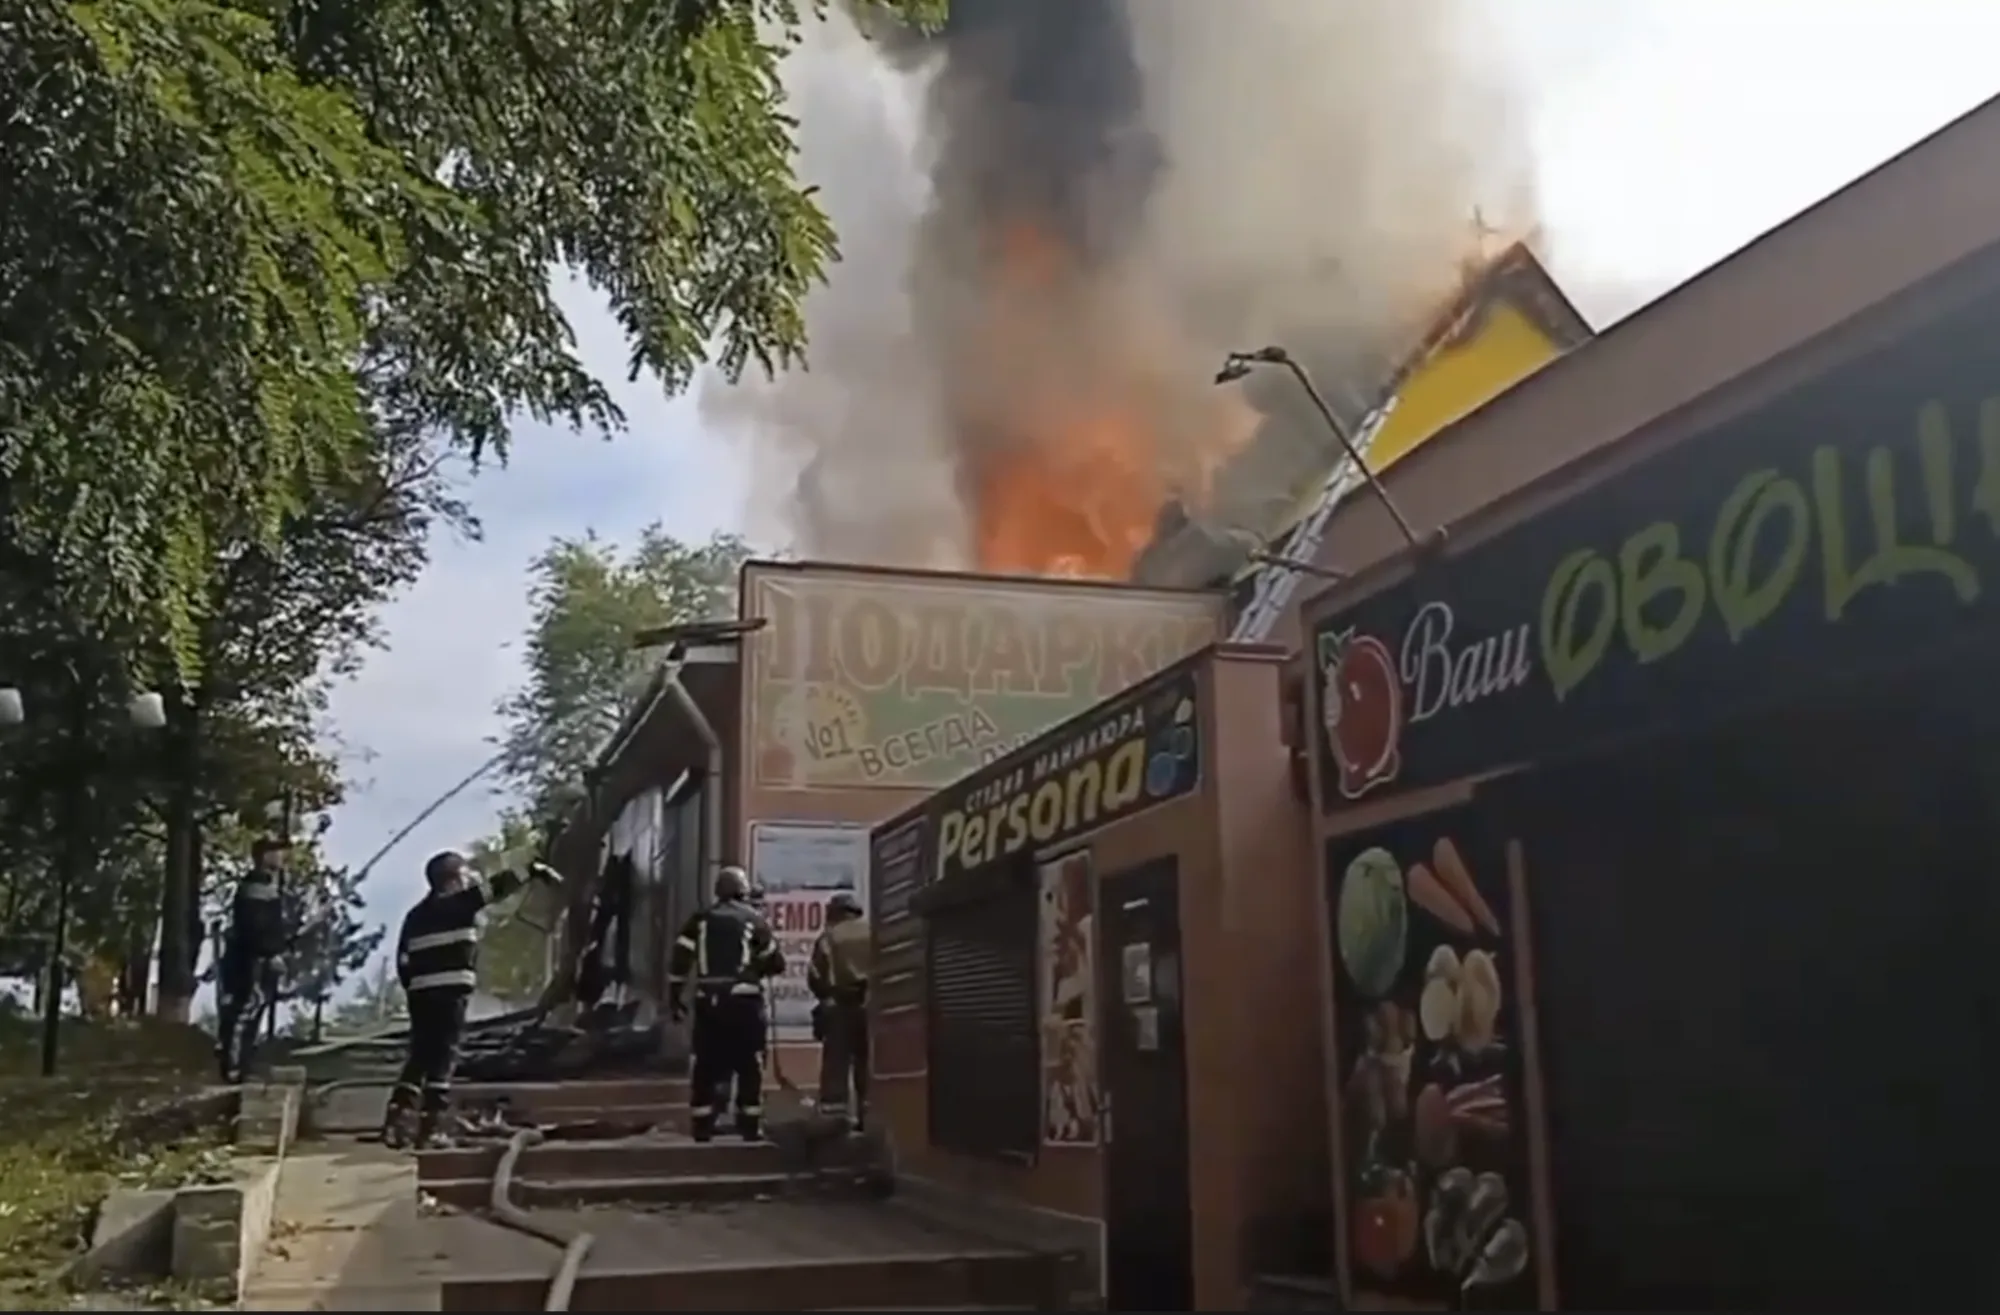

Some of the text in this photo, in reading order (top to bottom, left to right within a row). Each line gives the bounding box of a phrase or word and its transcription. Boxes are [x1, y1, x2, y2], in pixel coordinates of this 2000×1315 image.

[1401, 601, 1532, 723] Ваш
[859, 709, 995, 777] ВСЕГДА
[965, 767, 1025, 813] СТУДИЯ
[1033, 704, 1146, 781] МАНИКЮРА
[937, 738, 1147, 881] Persona
